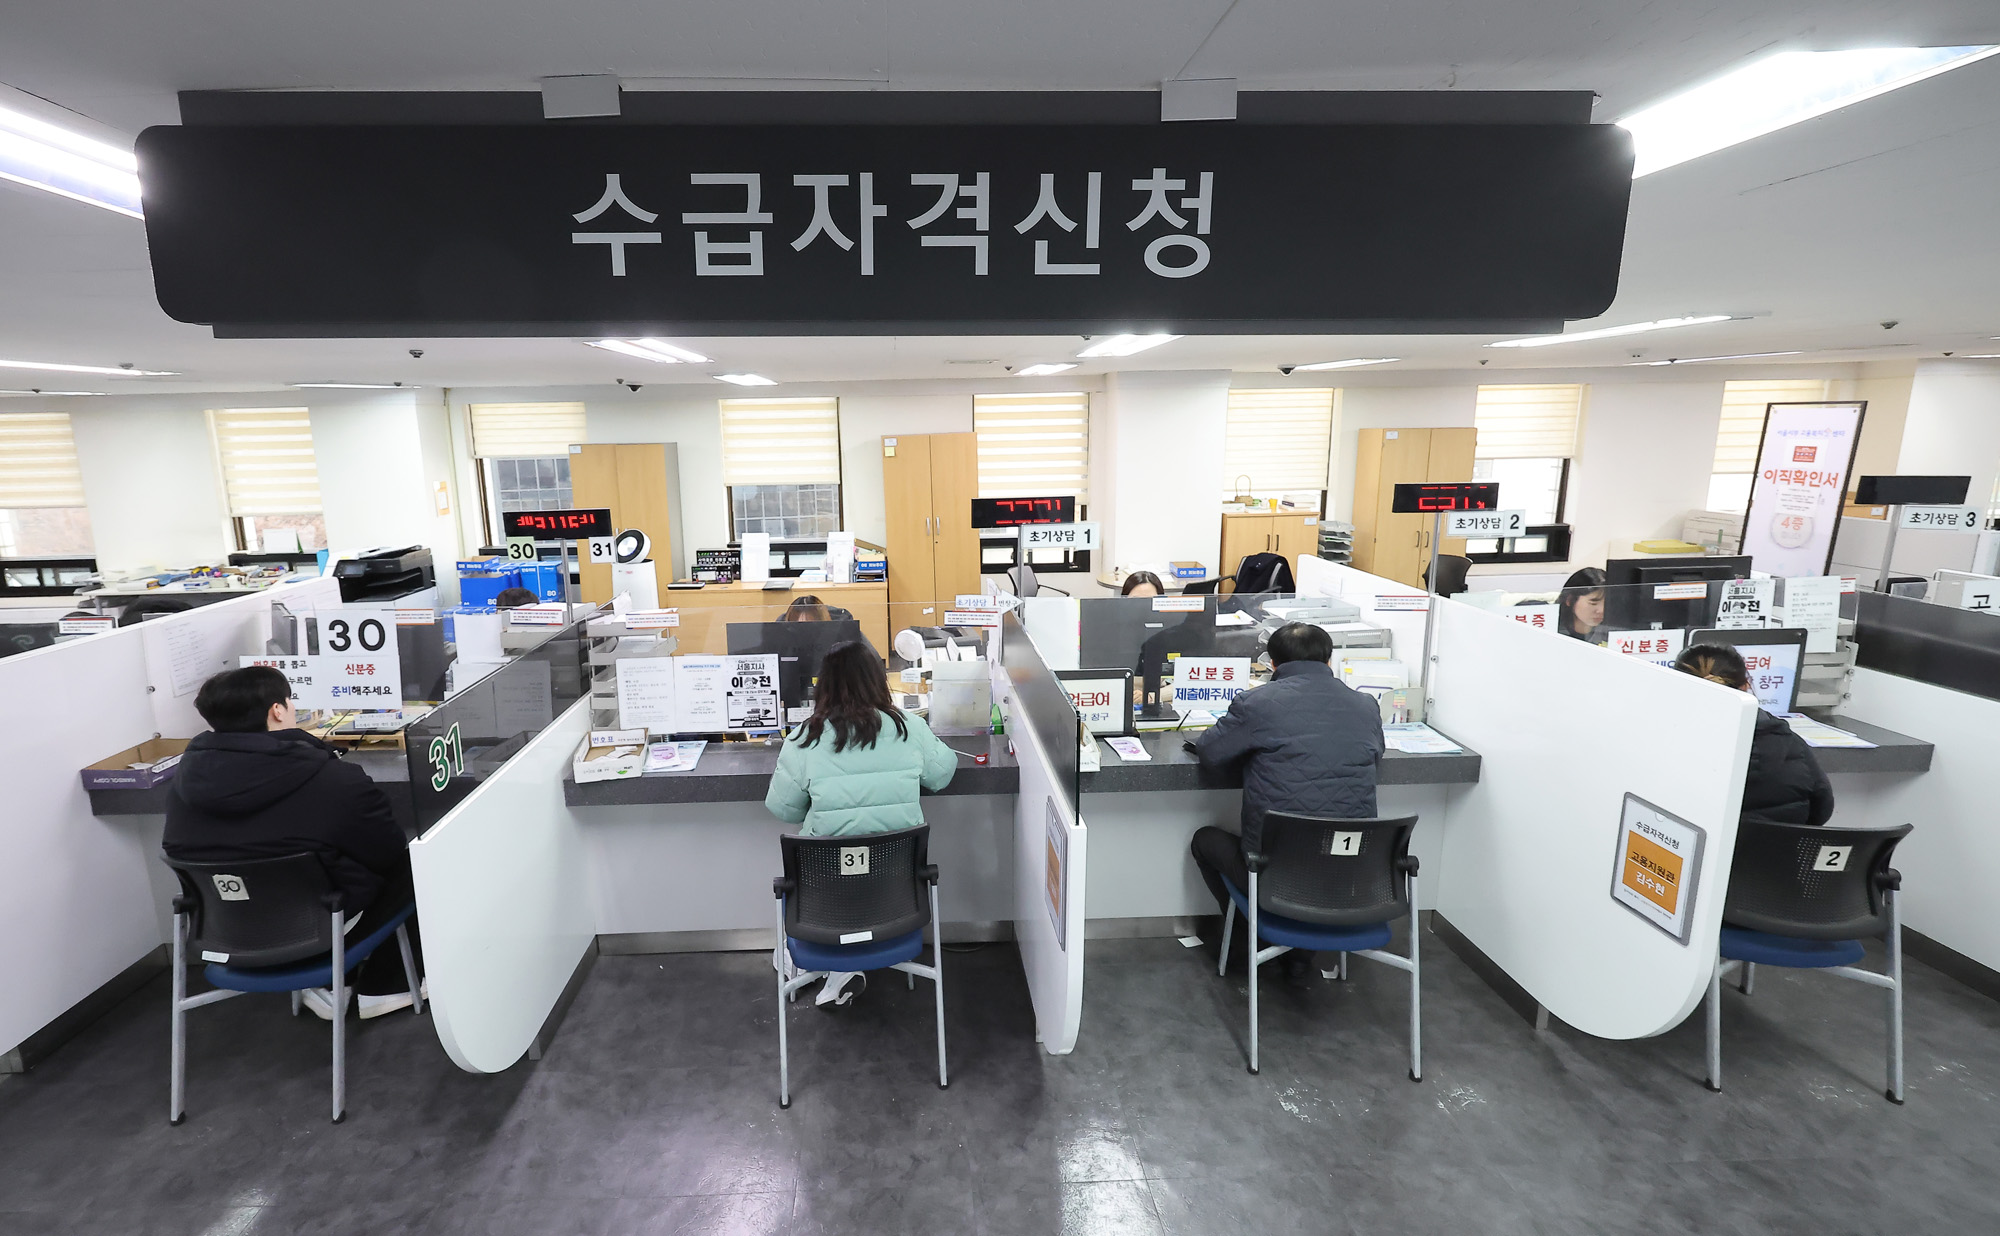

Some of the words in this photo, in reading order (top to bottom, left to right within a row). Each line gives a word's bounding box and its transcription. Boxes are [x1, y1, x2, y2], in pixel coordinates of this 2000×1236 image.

[571, 168, 1214, 278] 수급자격신청
[1763, 469, 1839, 488] 이직확인서
[1455, 517, 1501, 530] 초기상담
[1509, 514, 1520, 530] 2
[1909, 512, 1959, 526] 초기상담
[1965, 511, 1976, 527] 3
[1029, 530, 1075, 542] 초기상담
[1084, 529, 1091, 544] 1
[510, 543, 535, 559] 30
[592, 542, 612, 557] 31
[957, 598, 987, 607] 초기상담
[328, 618, 386, 652] 30
[1759, 675, 1784, 690] 창구
[331, 686, 392, 697] 준비해주세요
[429, 721, 465, 792] 31
[1635, 820, 1680, 850] 수급자격신청
[1343, 836, 1351, 851] 1
[844, 853, 865, 867] 31
[1826, 851, 1841, 866] 2
[1631, 851, 1676, 884] 고용지원관
[217, 880, 241, 893] 30
